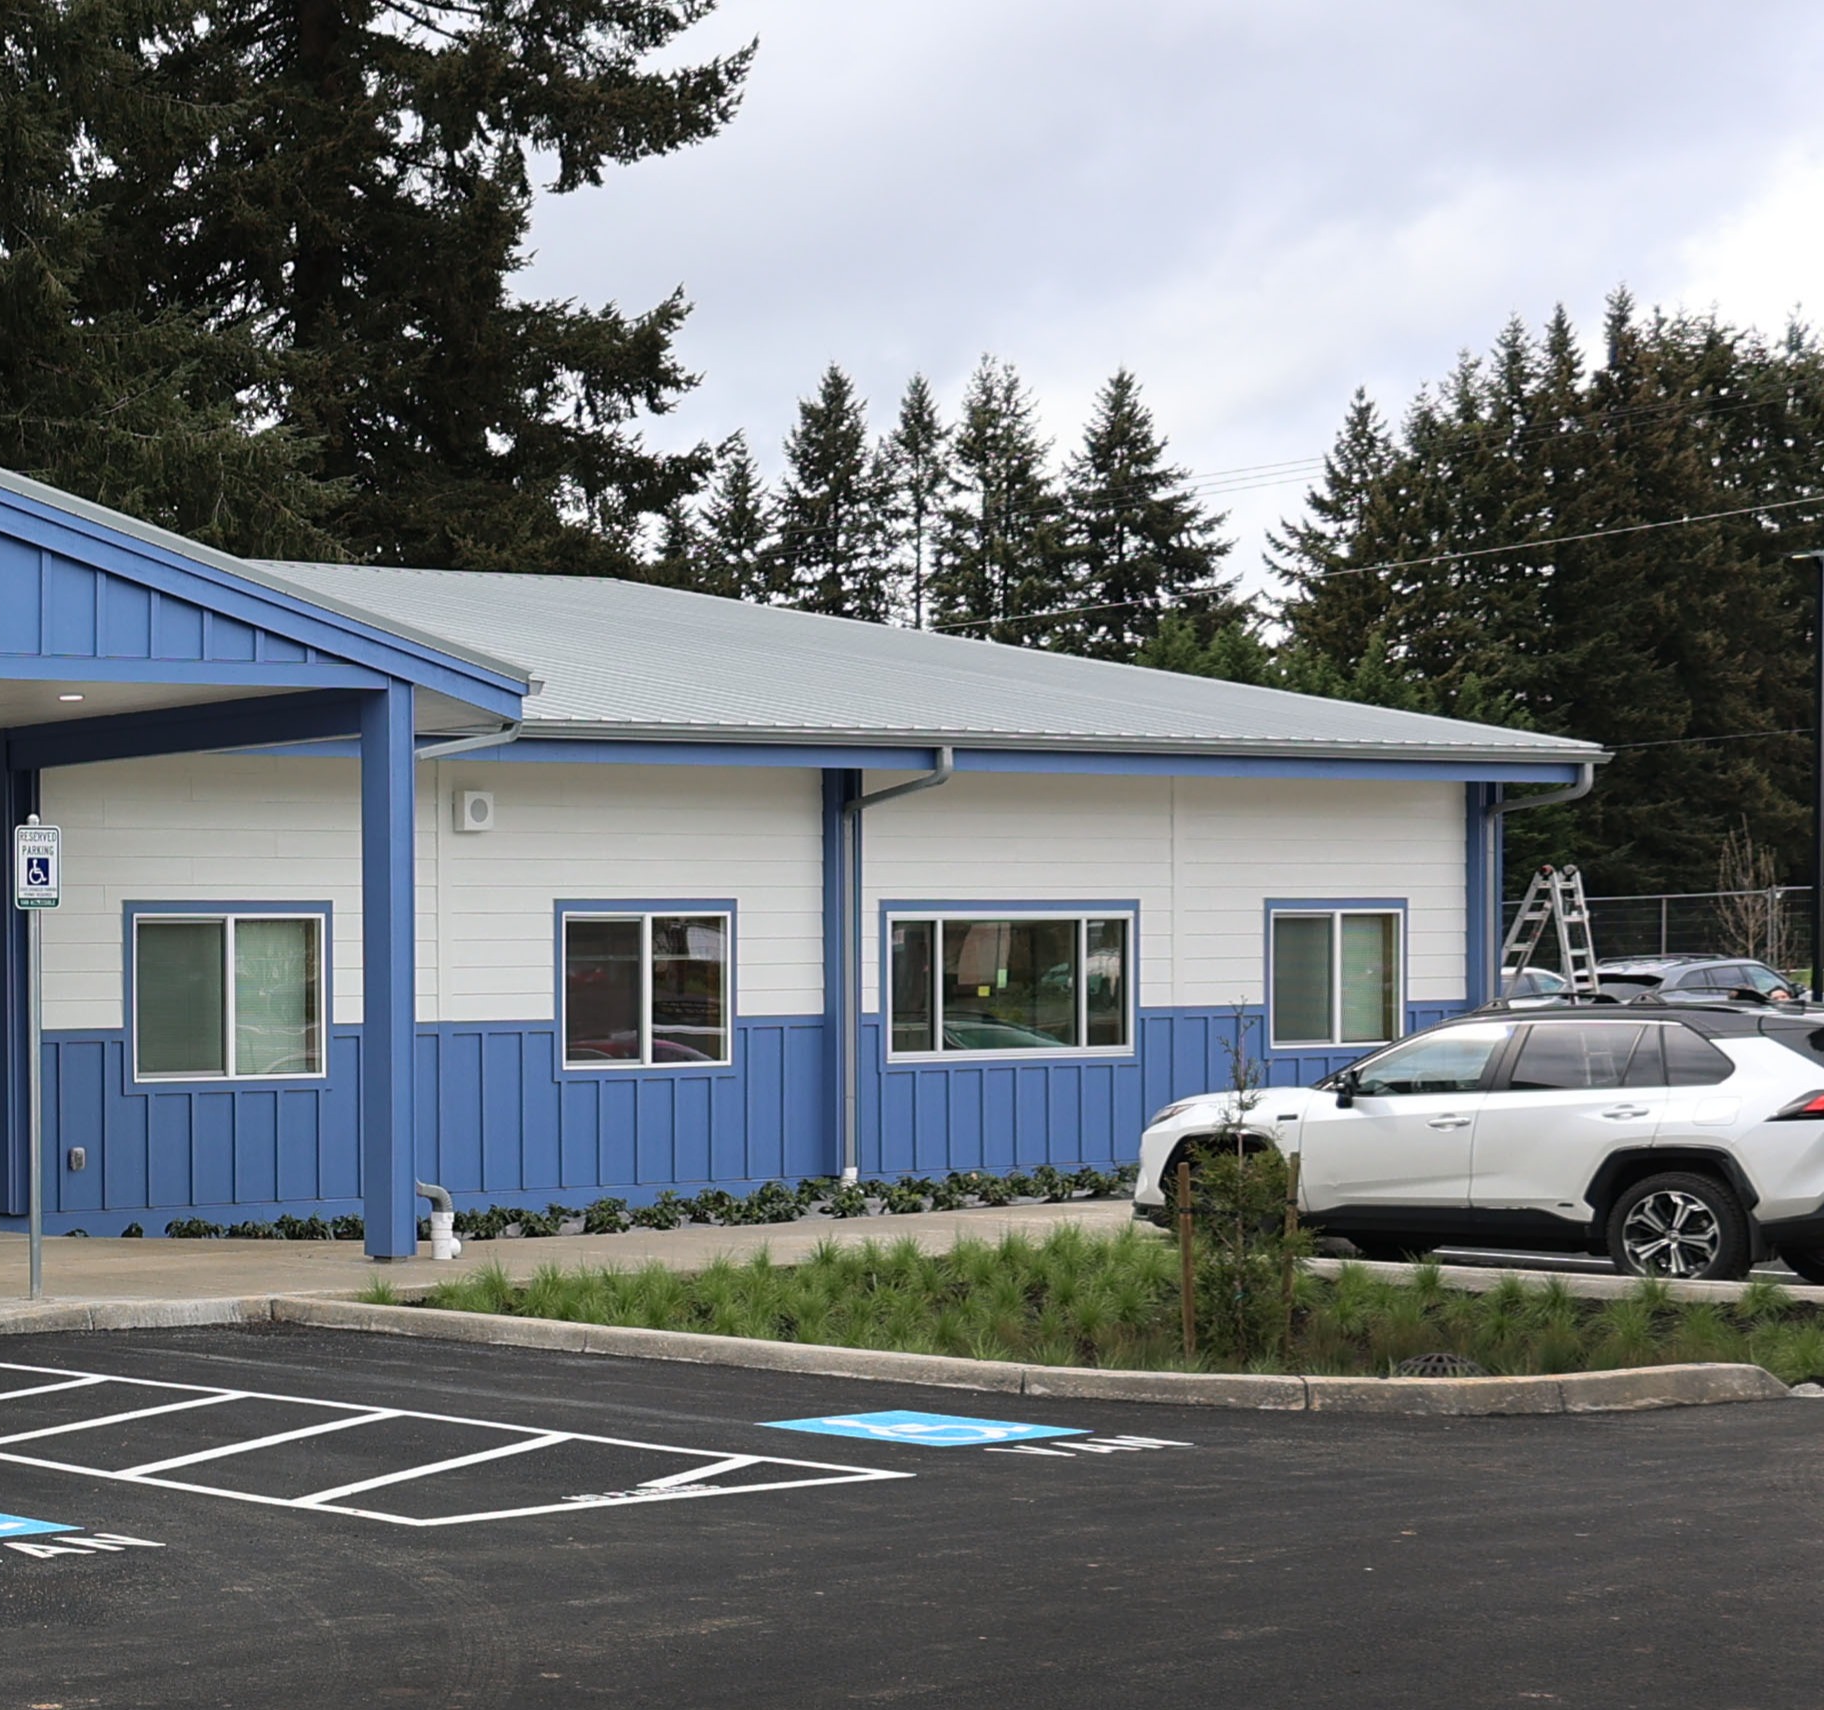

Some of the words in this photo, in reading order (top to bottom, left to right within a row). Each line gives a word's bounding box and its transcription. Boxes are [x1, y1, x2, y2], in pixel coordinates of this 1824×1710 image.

[19, 831, 57, 842] RESERVED
[22, 845, 55, 856] PARKING
[983, 1435, 1195, 1457] VAN
